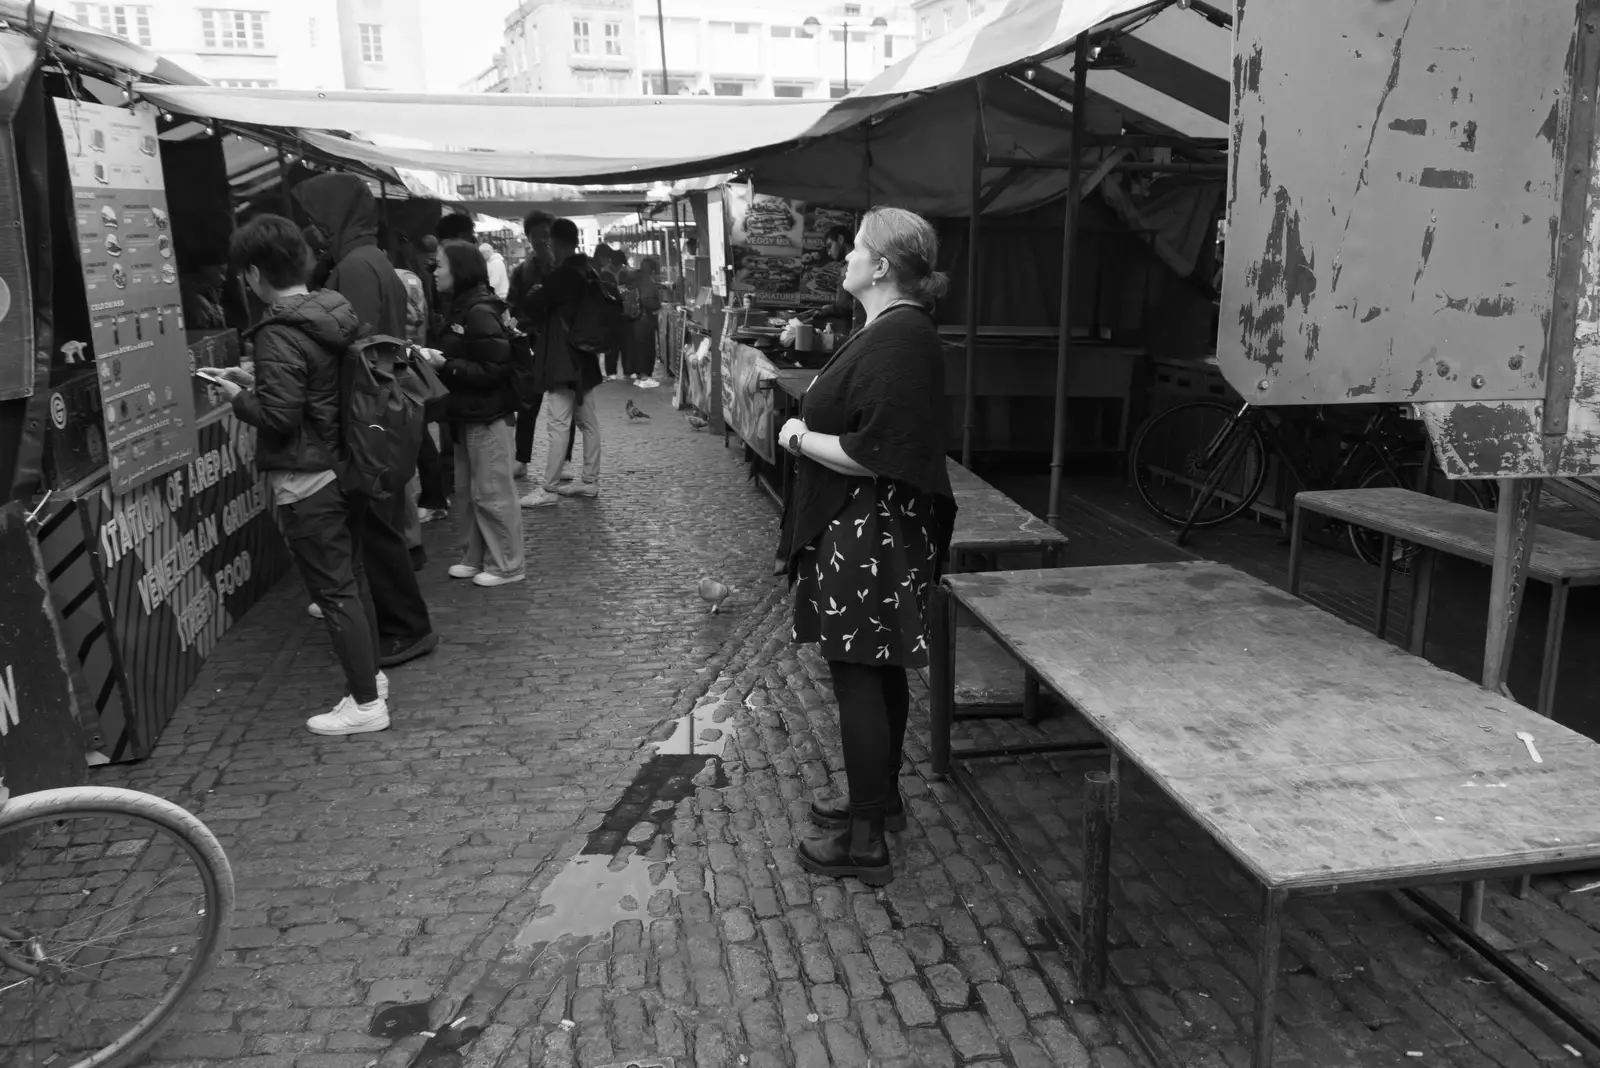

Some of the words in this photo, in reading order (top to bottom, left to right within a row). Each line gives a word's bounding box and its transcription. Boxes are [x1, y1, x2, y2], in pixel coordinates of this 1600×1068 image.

[746, 237, 774, 245] VEGGY
[776, 237, 791, 246] MIX
[101, 485, 164, 568] STATION
[166, 470, 184, 512] OF
[188, 441, 237, 498] AREPAS
[137, 513, 219, 616] VENEZUELAN
[222, 481, 267, 536] GRILLED
[177, 580, 214, 652] STREET
[215, 550, 251, 606] FOOD
